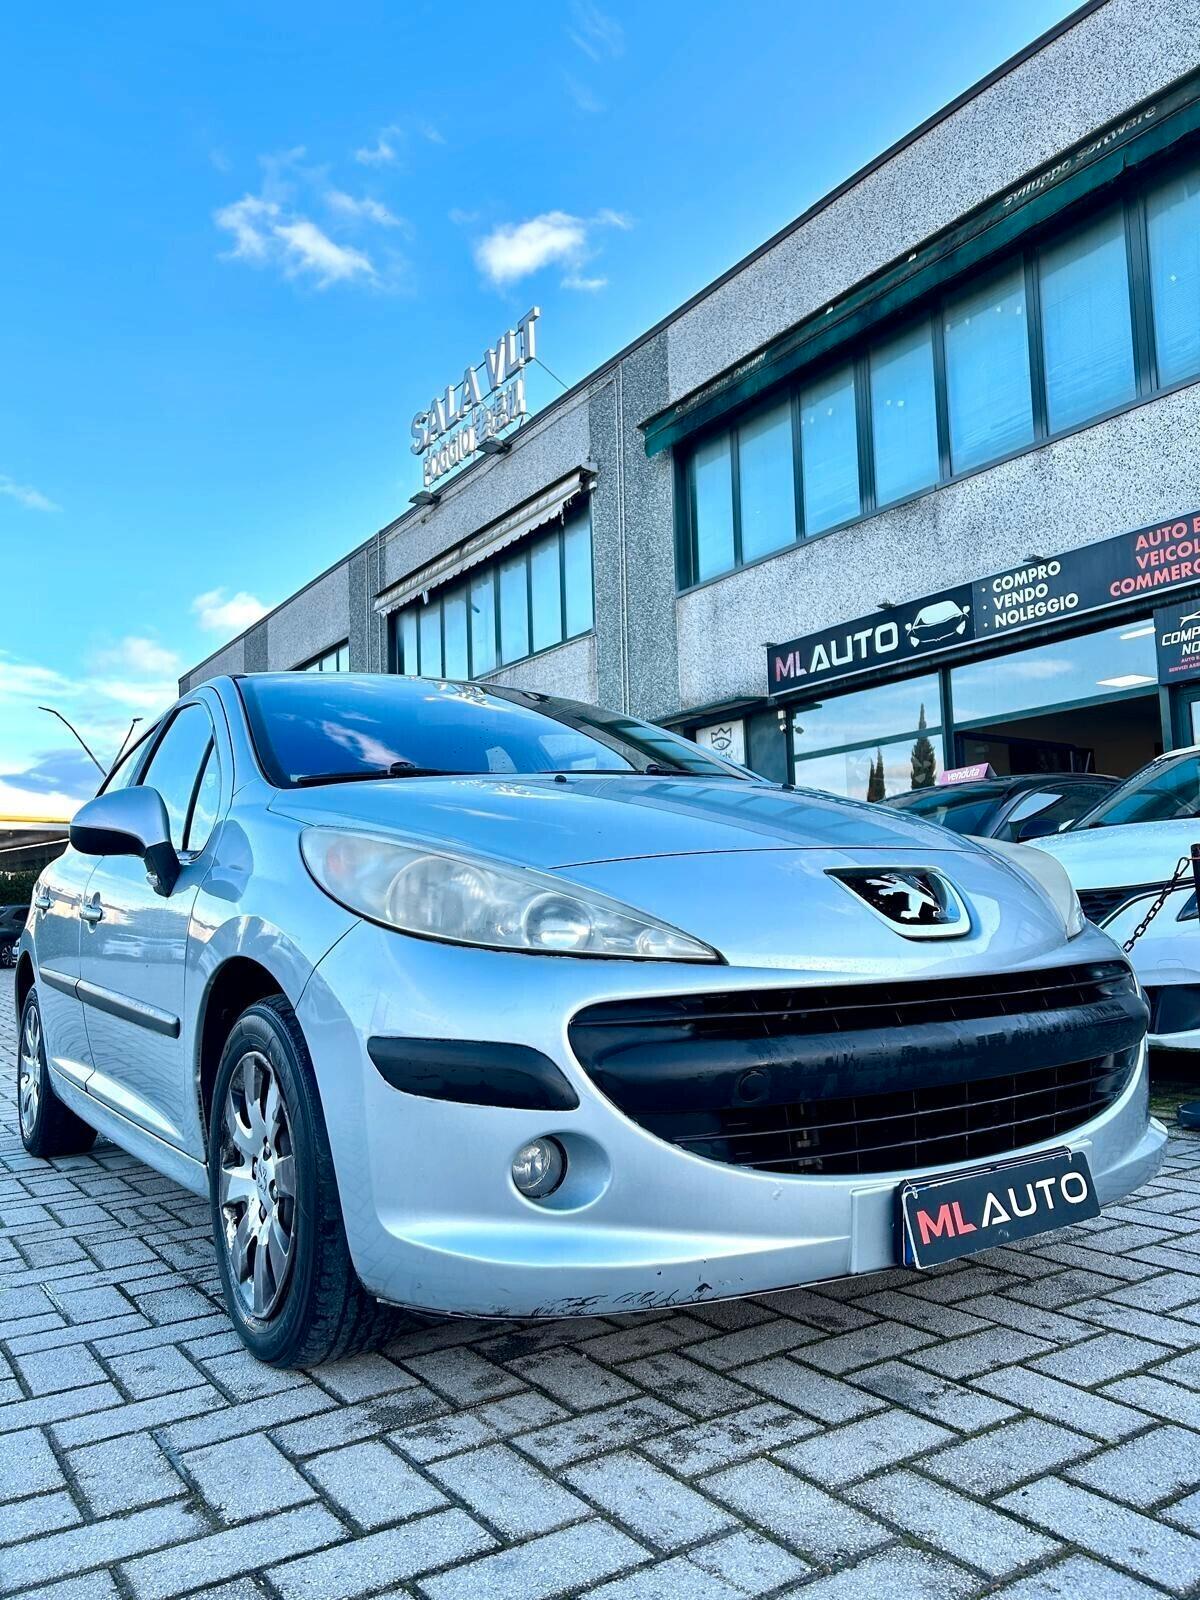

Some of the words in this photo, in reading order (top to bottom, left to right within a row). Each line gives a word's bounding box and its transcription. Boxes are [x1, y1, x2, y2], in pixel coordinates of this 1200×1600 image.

[410, 366, 481, 456] SALA
[484, 306, 541, 391] VLT
[1135, 522, 1188, 551] AUTO
[992, 560, 1061, 593] COMPRO
[993, 583, 1049, 610] VENDO
[994, 592, 1079, 629] NOLEGGIO
[947, 767, 981, 782] venduta
